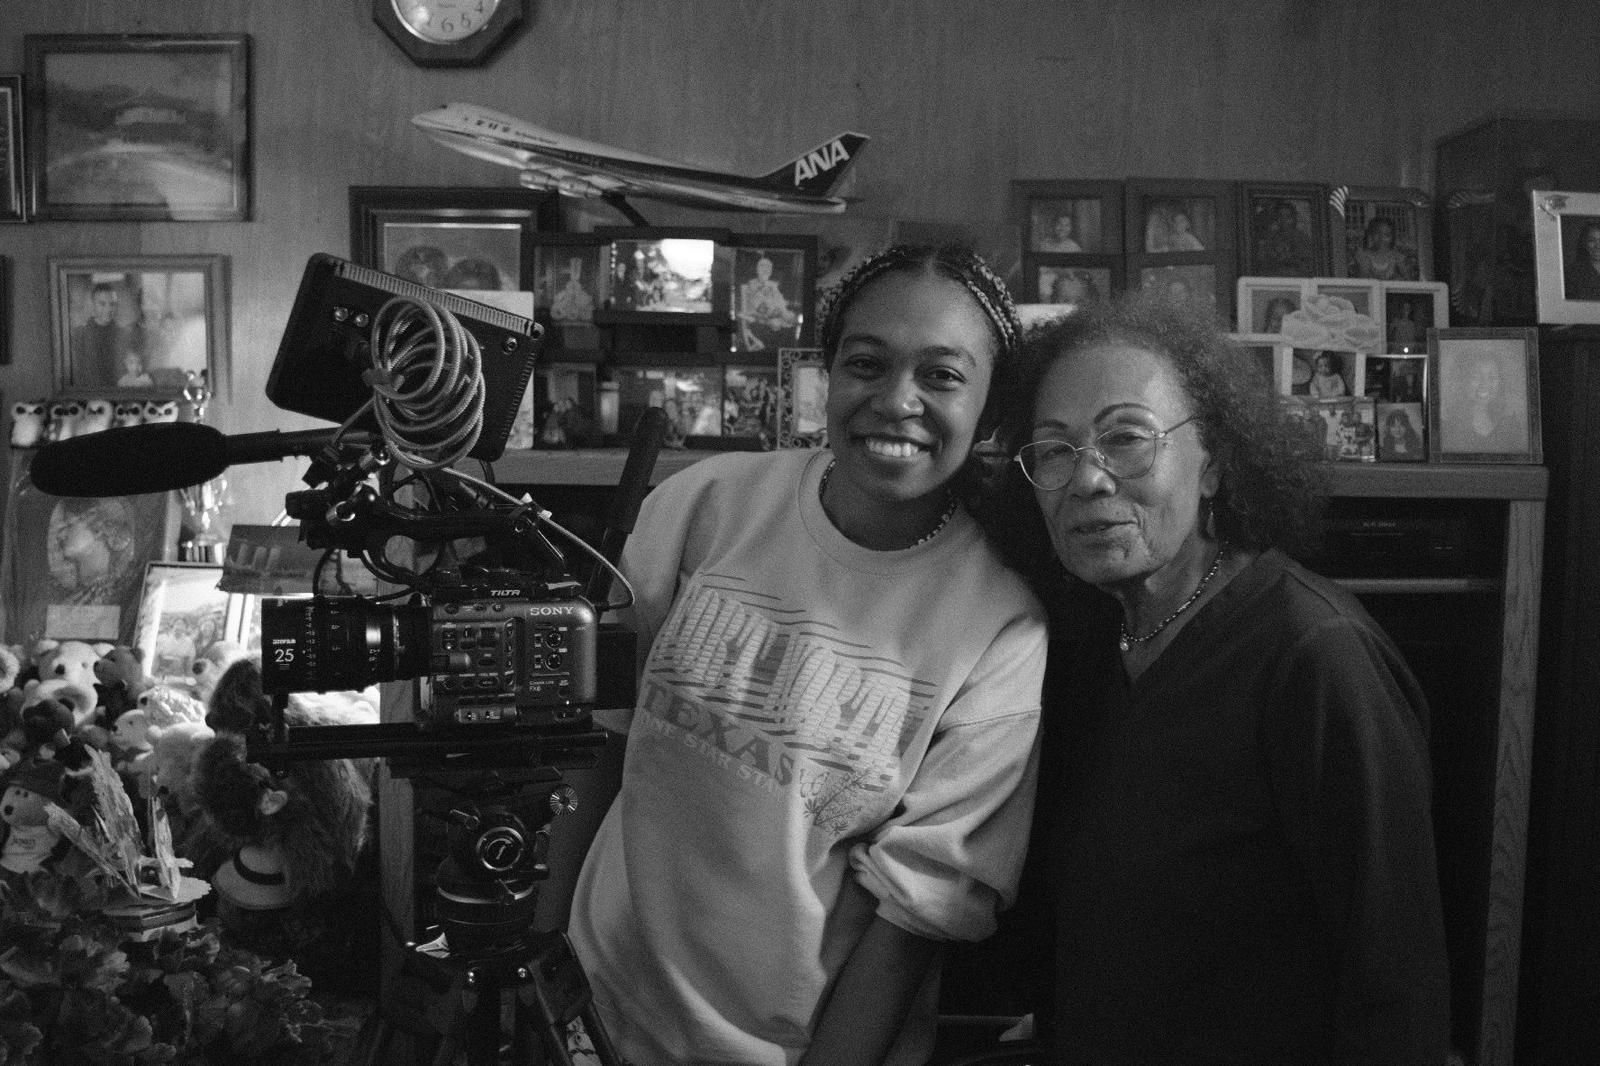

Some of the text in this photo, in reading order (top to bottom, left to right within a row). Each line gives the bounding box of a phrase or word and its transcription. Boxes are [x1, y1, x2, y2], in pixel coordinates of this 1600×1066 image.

[441, 16, 454, 33] 6
[793, 140, 850, 187] ANA
[530, 606, 574, 616] SONY
[274, 648, 295, 662] 25
[644, 680, 795, 785] TEXAS
